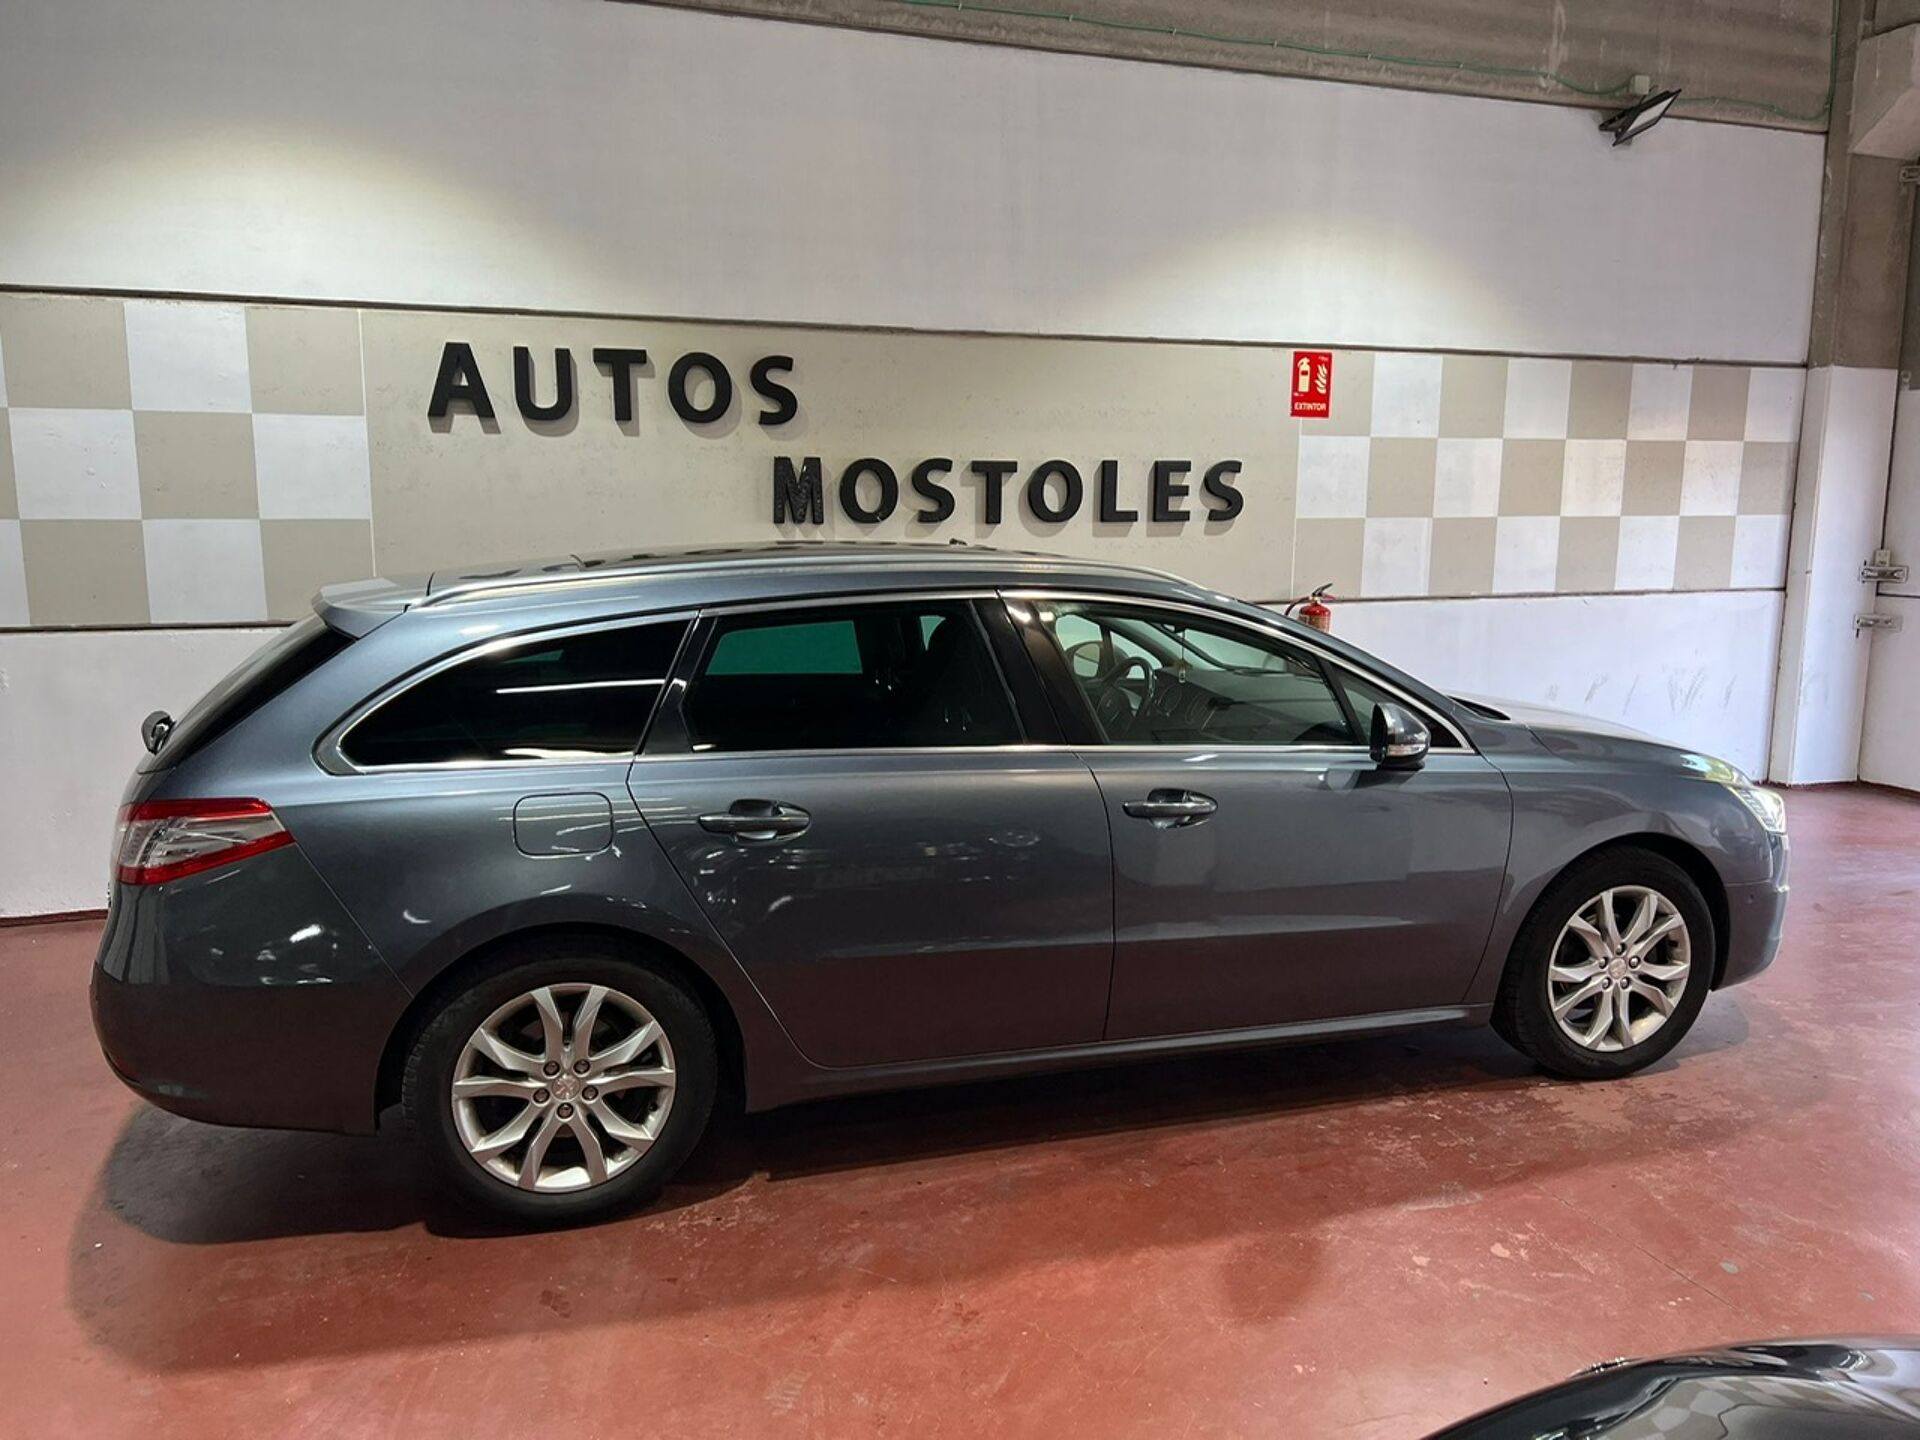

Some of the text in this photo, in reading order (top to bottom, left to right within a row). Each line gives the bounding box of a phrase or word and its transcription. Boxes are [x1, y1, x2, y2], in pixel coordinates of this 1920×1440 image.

[427, 341, 798, 426] AUTOS
[1294, 402, 1327, 411] EXTINTOR
[773, 456, 1243, 526] MOSTOLES
